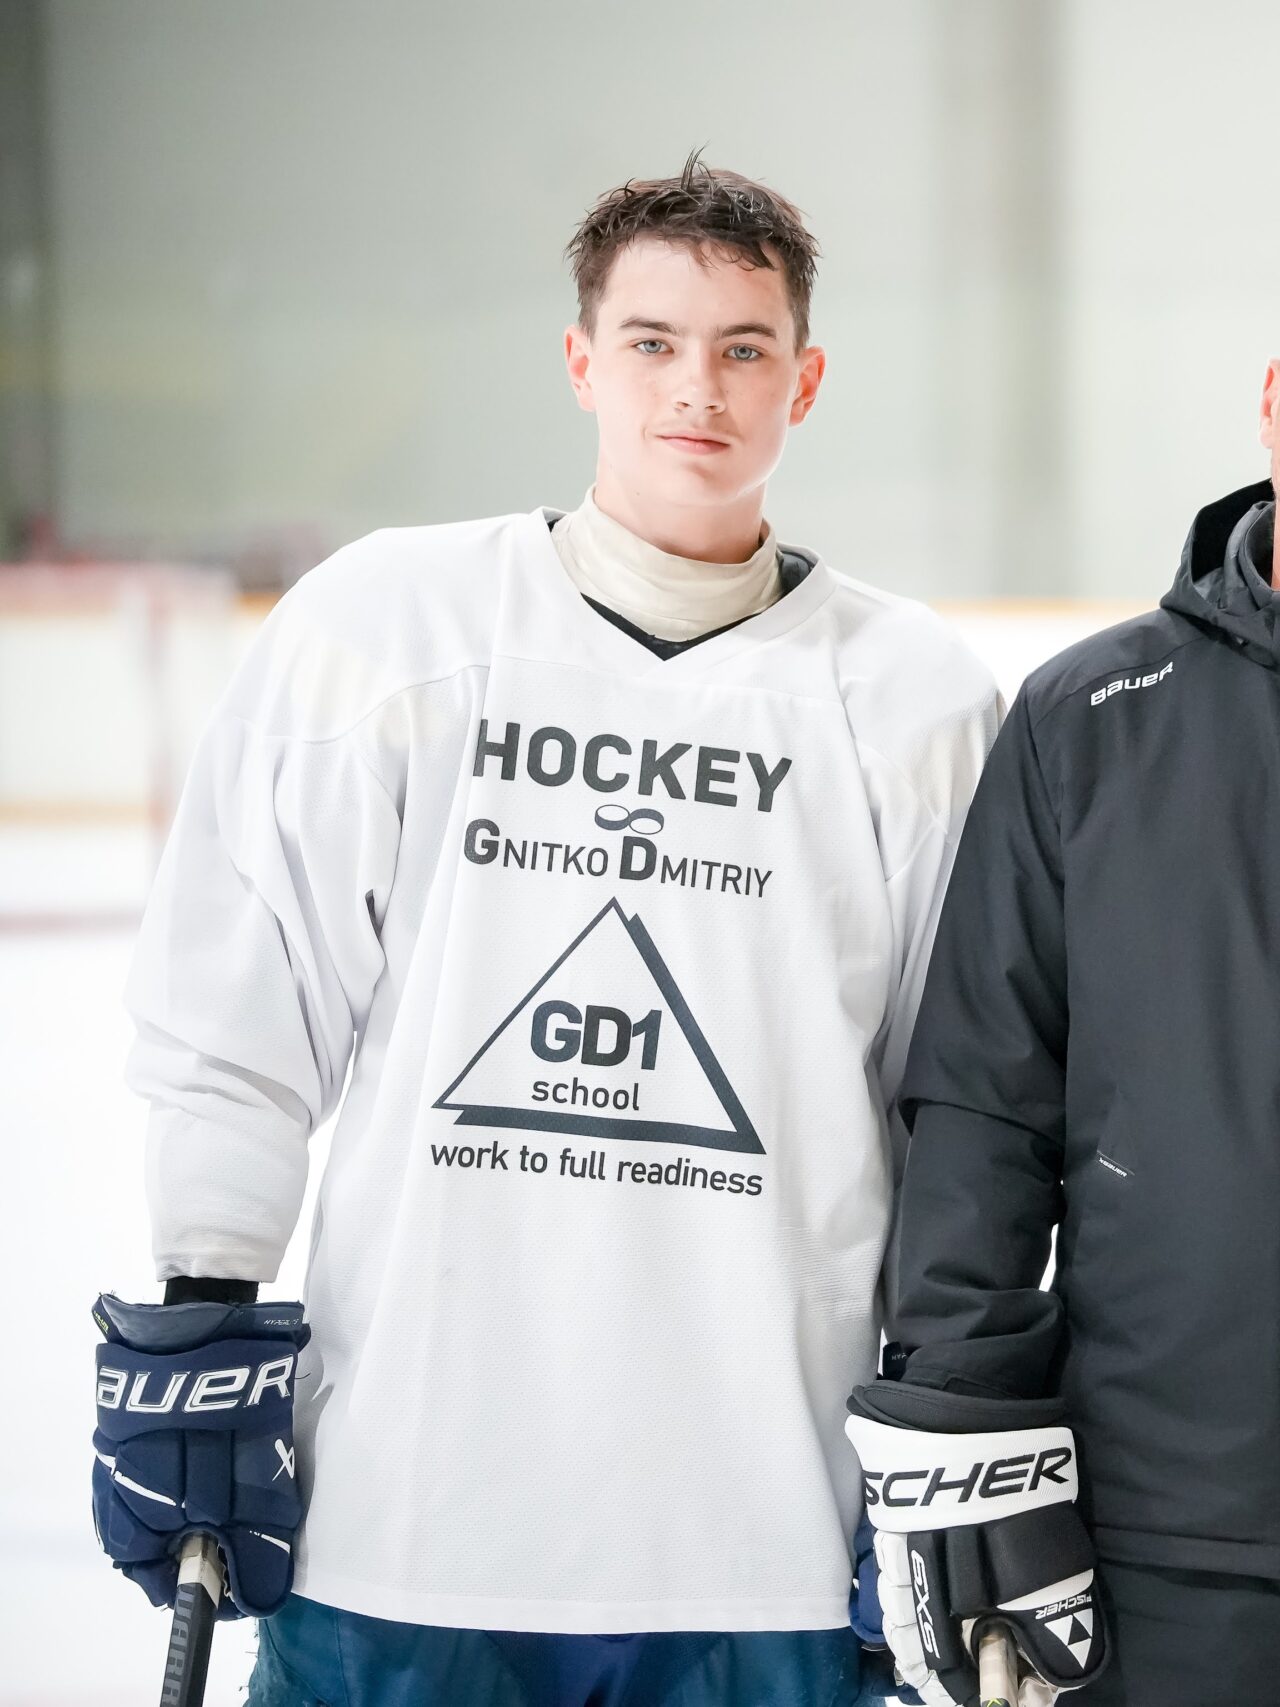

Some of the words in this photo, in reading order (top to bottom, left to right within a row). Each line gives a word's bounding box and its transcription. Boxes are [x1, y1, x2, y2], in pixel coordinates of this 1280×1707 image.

[1090, 661, 1174, 706] BAUER
[473, 719, 793, 813] HOCKEY
[463, 818, 609, 877] GNITKO
[619, 835, 773, 898] DMITRIY
[530, 999, 663, 1071] GD1
[531, 1076, 640, 1111] school
[431, 1142, 509, 1171] work
[519, 1145, 548, 1173] to
[559, 1147, 606, 1181] full
[616, 1157, 763, 1196] readiness
[1035, 1593, 1093, 1620] FISCHER
